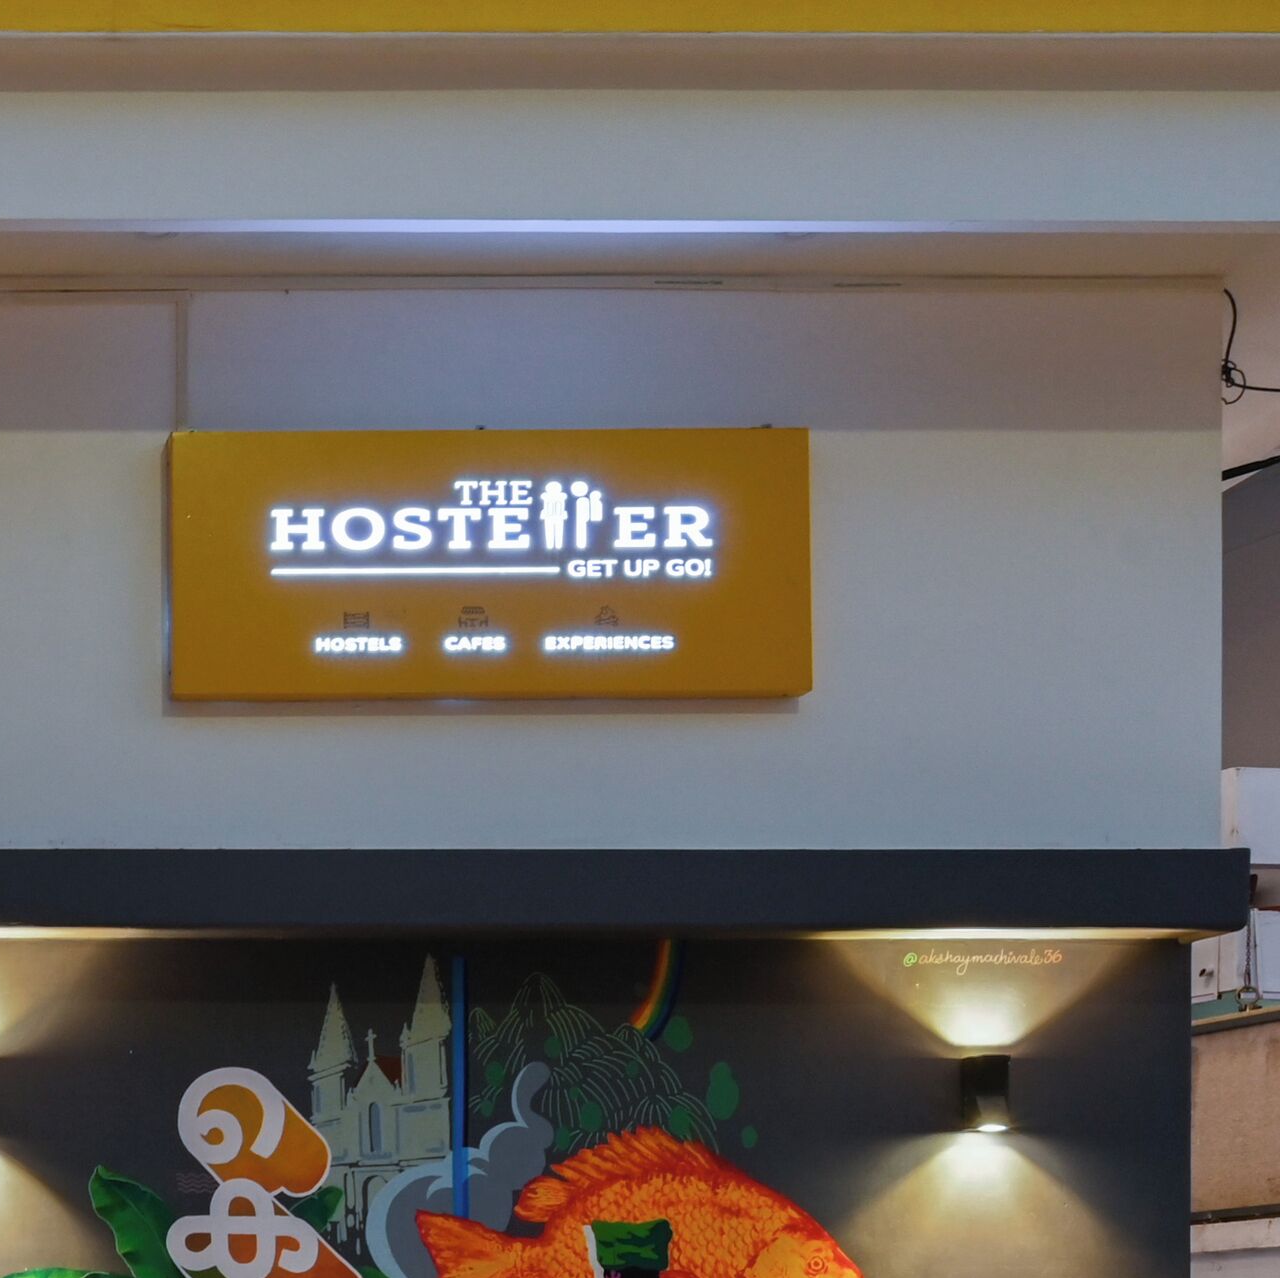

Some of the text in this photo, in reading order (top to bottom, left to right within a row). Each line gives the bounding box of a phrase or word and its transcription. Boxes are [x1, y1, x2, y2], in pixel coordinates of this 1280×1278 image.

[454, 480, 533, 506] THE
[567, 558, 712, 577] GET UP GO!
[315, 635, 675, 651] HOSTELS CAFES EXPERIENCES
